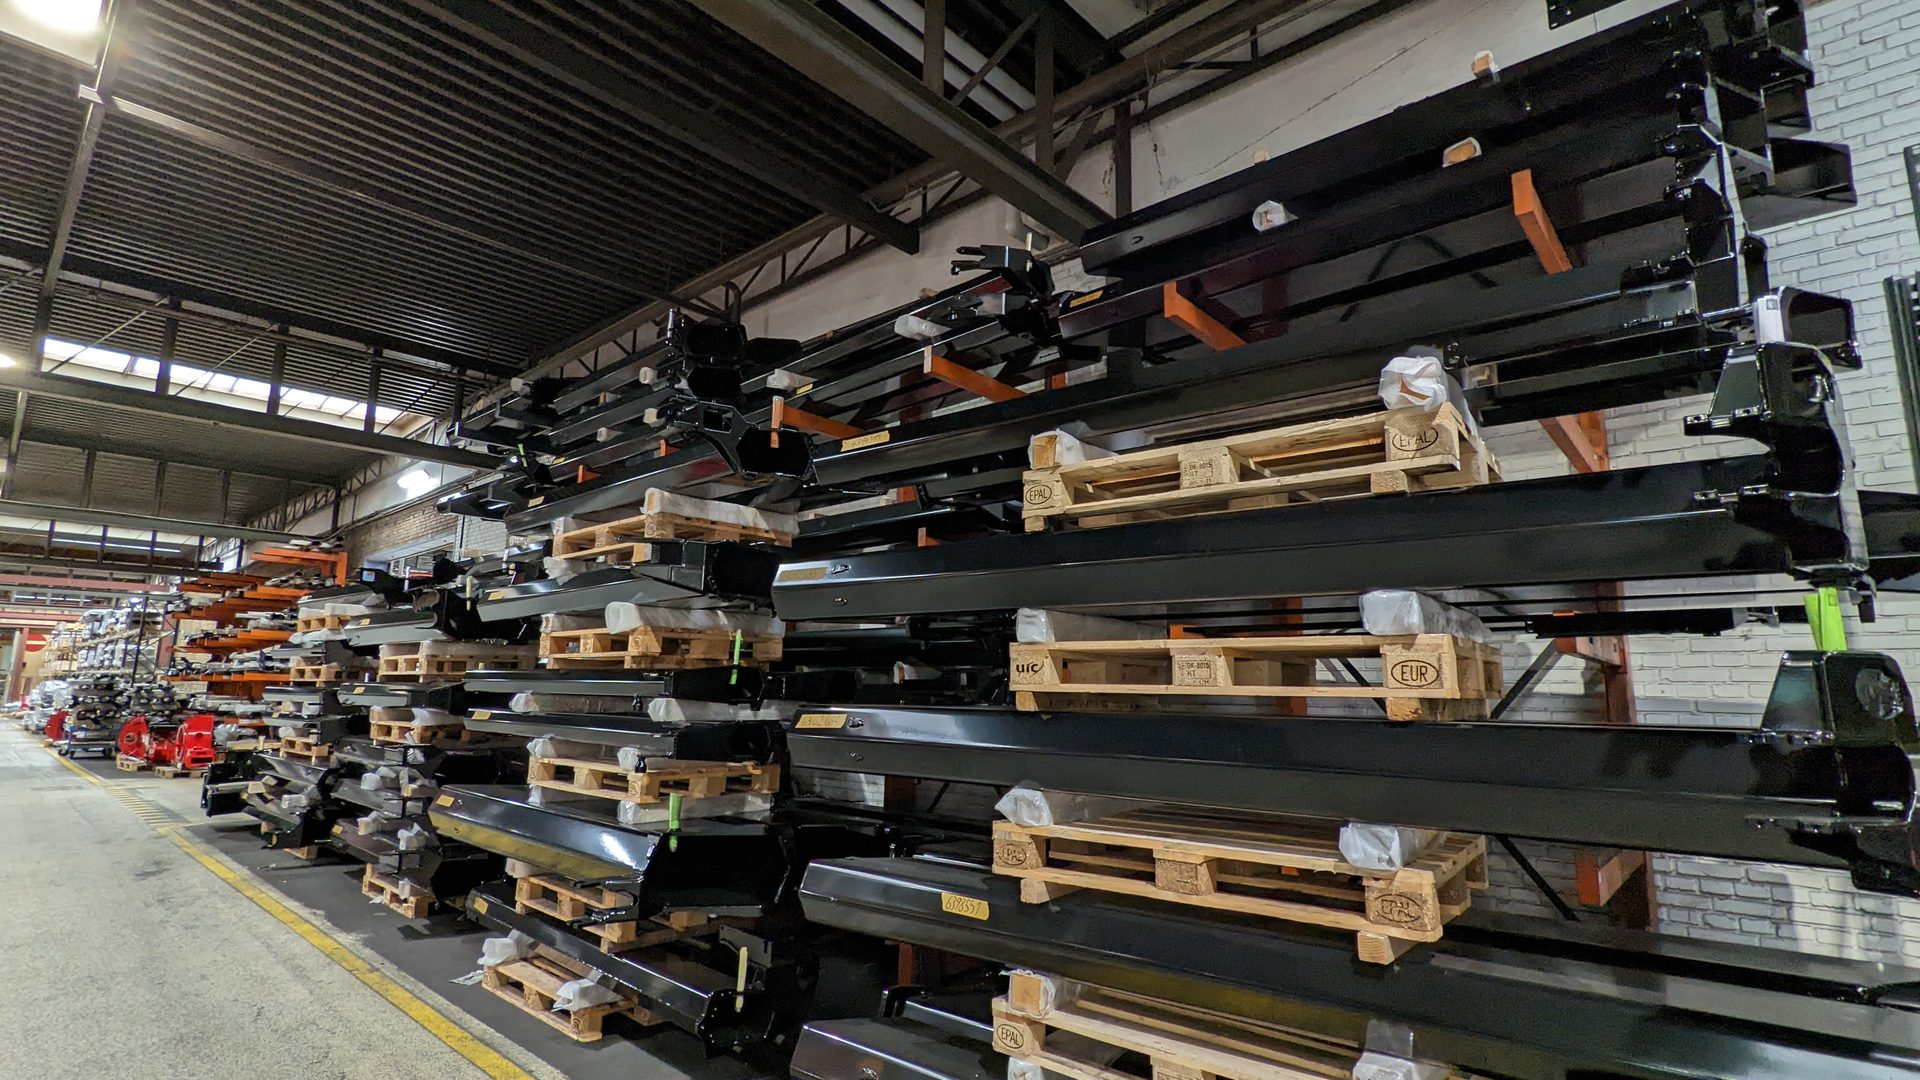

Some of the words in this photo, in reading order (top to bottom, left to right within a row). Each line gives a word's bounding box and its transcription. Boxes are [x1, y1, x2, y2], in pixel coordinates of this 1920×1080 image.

[1029, 488, 1048, 502] EPAL
[1401, 664, 1428, 682] EUR
[946, 895, 982, 915] 6398551
[1001, 1026, 1021, 1047] EPAL
